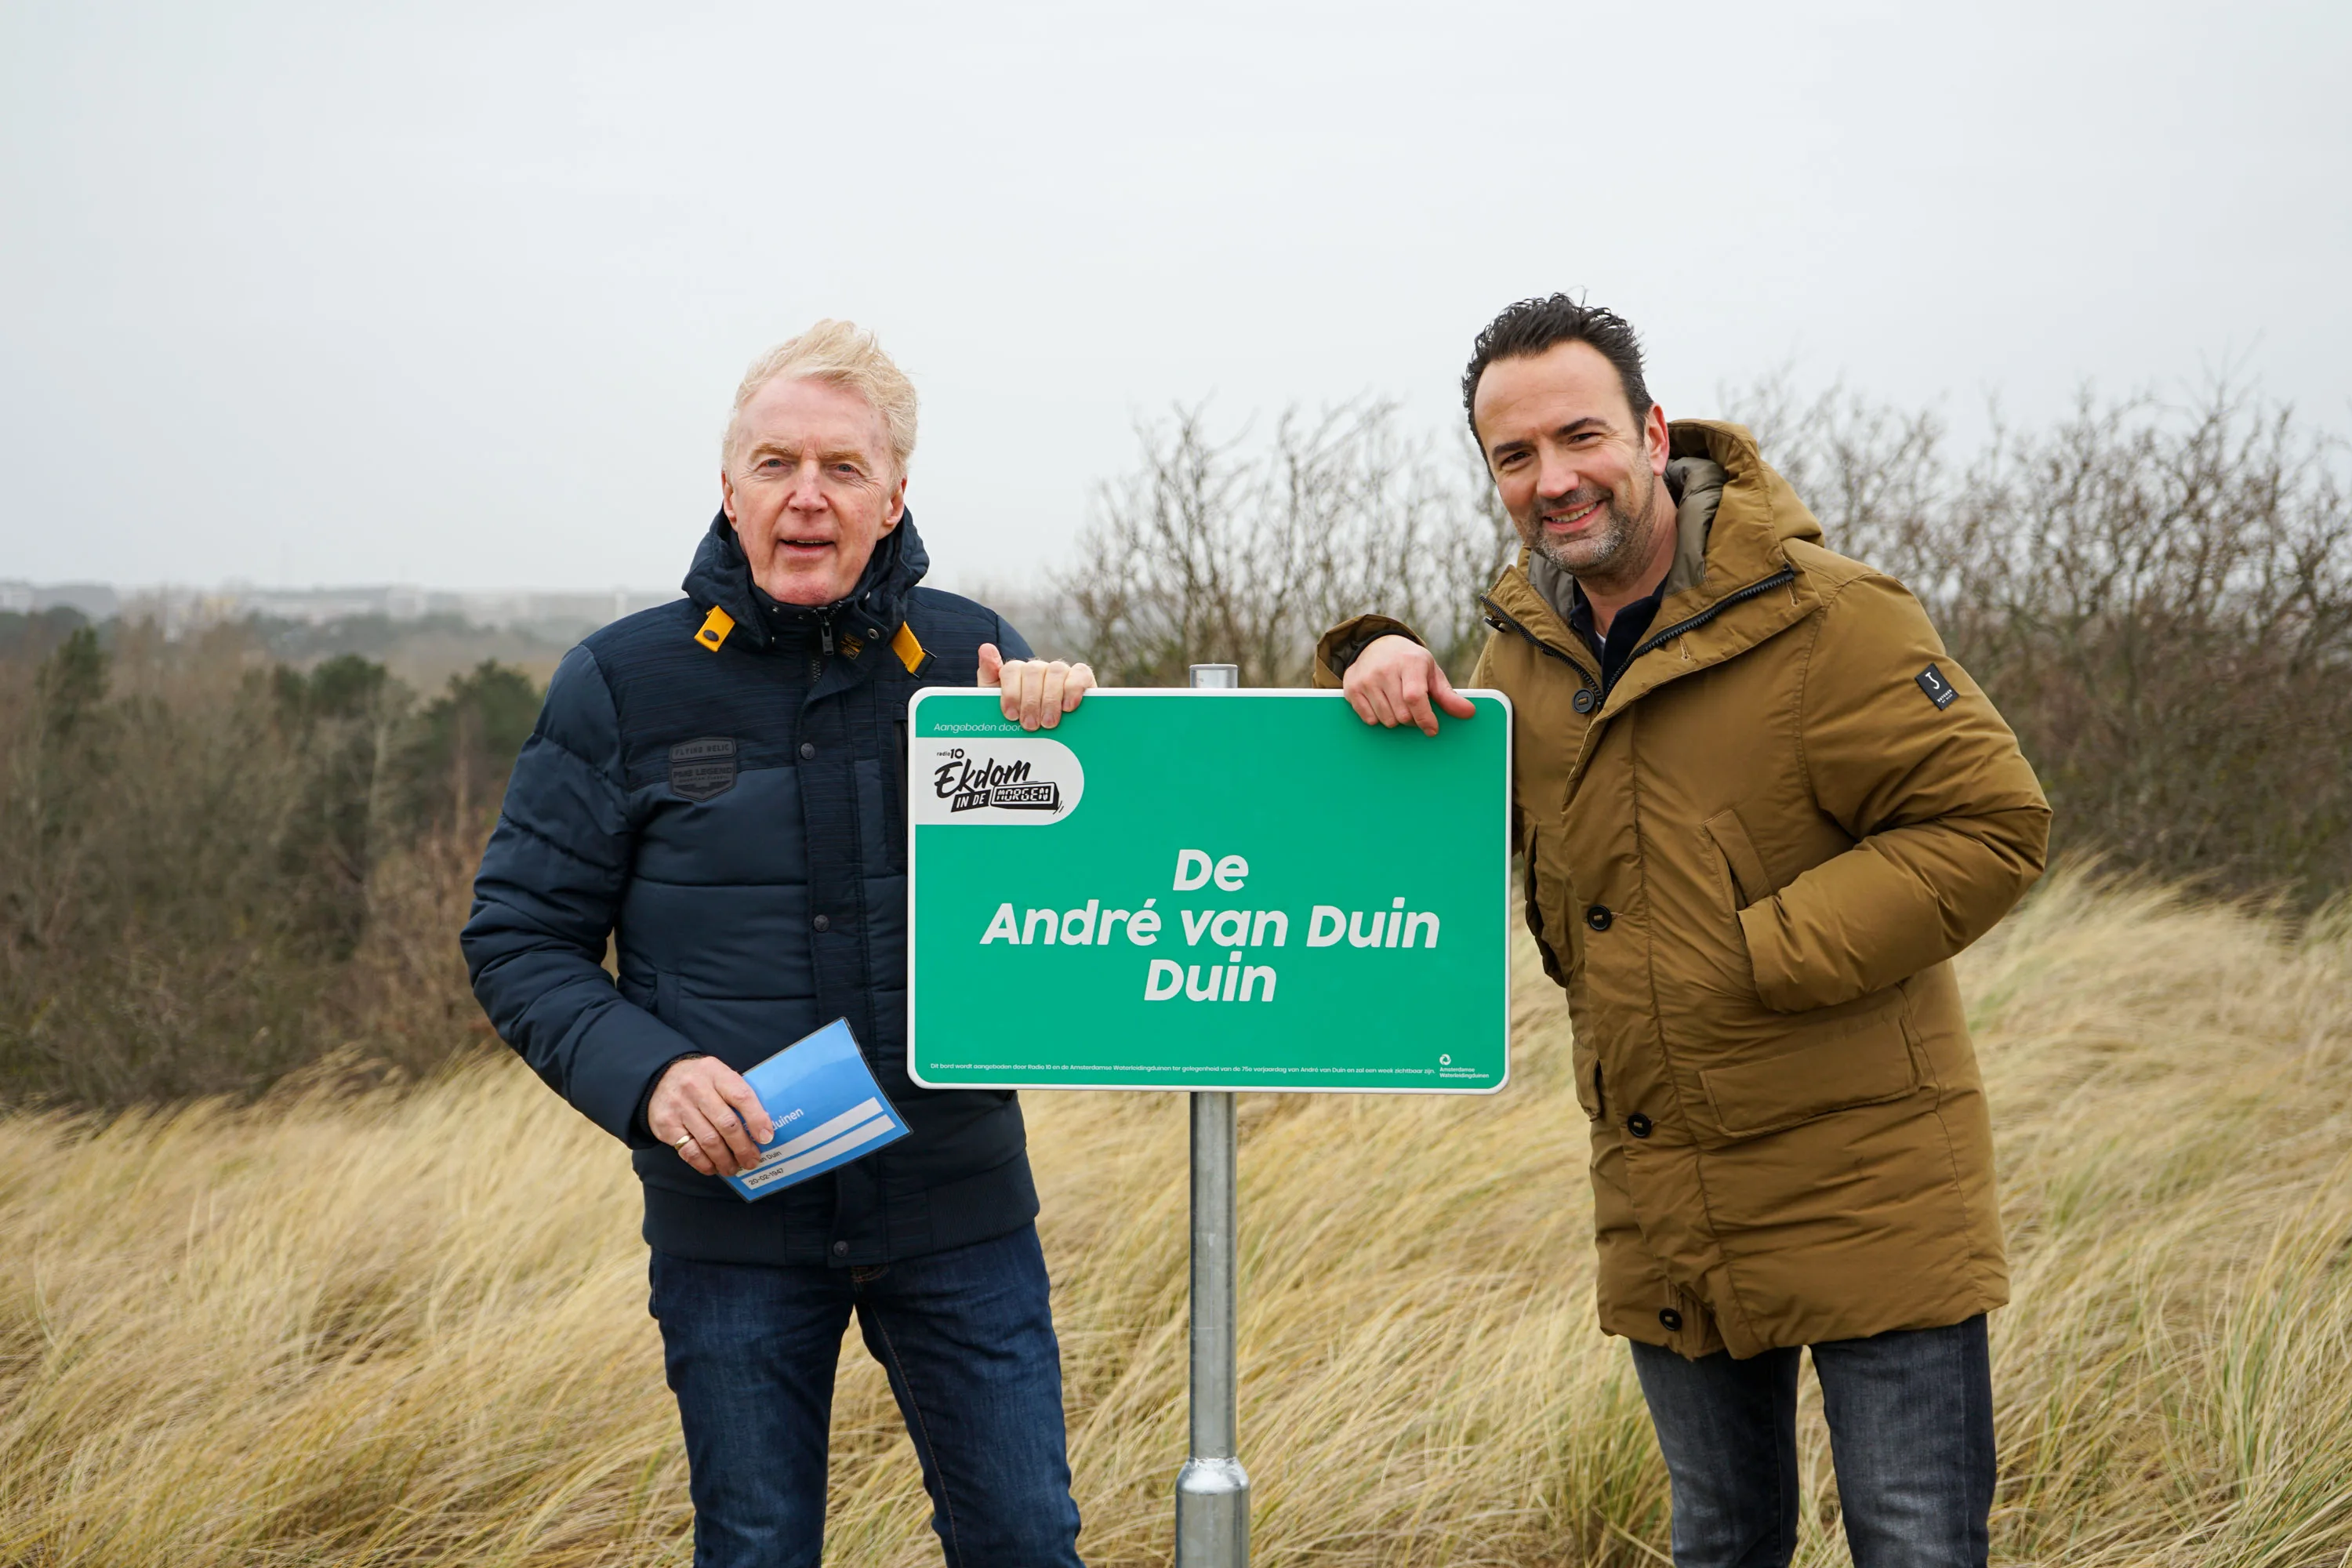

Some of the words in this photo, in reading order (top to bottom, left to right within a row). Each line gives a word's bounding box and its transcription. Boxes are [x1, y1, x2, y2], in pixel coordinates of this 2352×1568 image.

[934, 722, 996, 734] Aangeboden
[706, 743, 730, 753] RELIC
[934, 757, 1032, 799] Ekdom
[956, 795, 970, 809] IN
[972, 792, 987, 806] DE
[995, 787, 1050, 802] MORGEN
[1173, 849, 1249, 892] De
[980, 898, 1162, 946] André
[1181, 909, 1288, 947] van
[1306, 897, 1440, 949] Duin
[1144, 951, 1277, 1003] Duin
[766, 1150, 782, 1160] Duin
[748, 1167, 785, 1186] 20-02-1947
